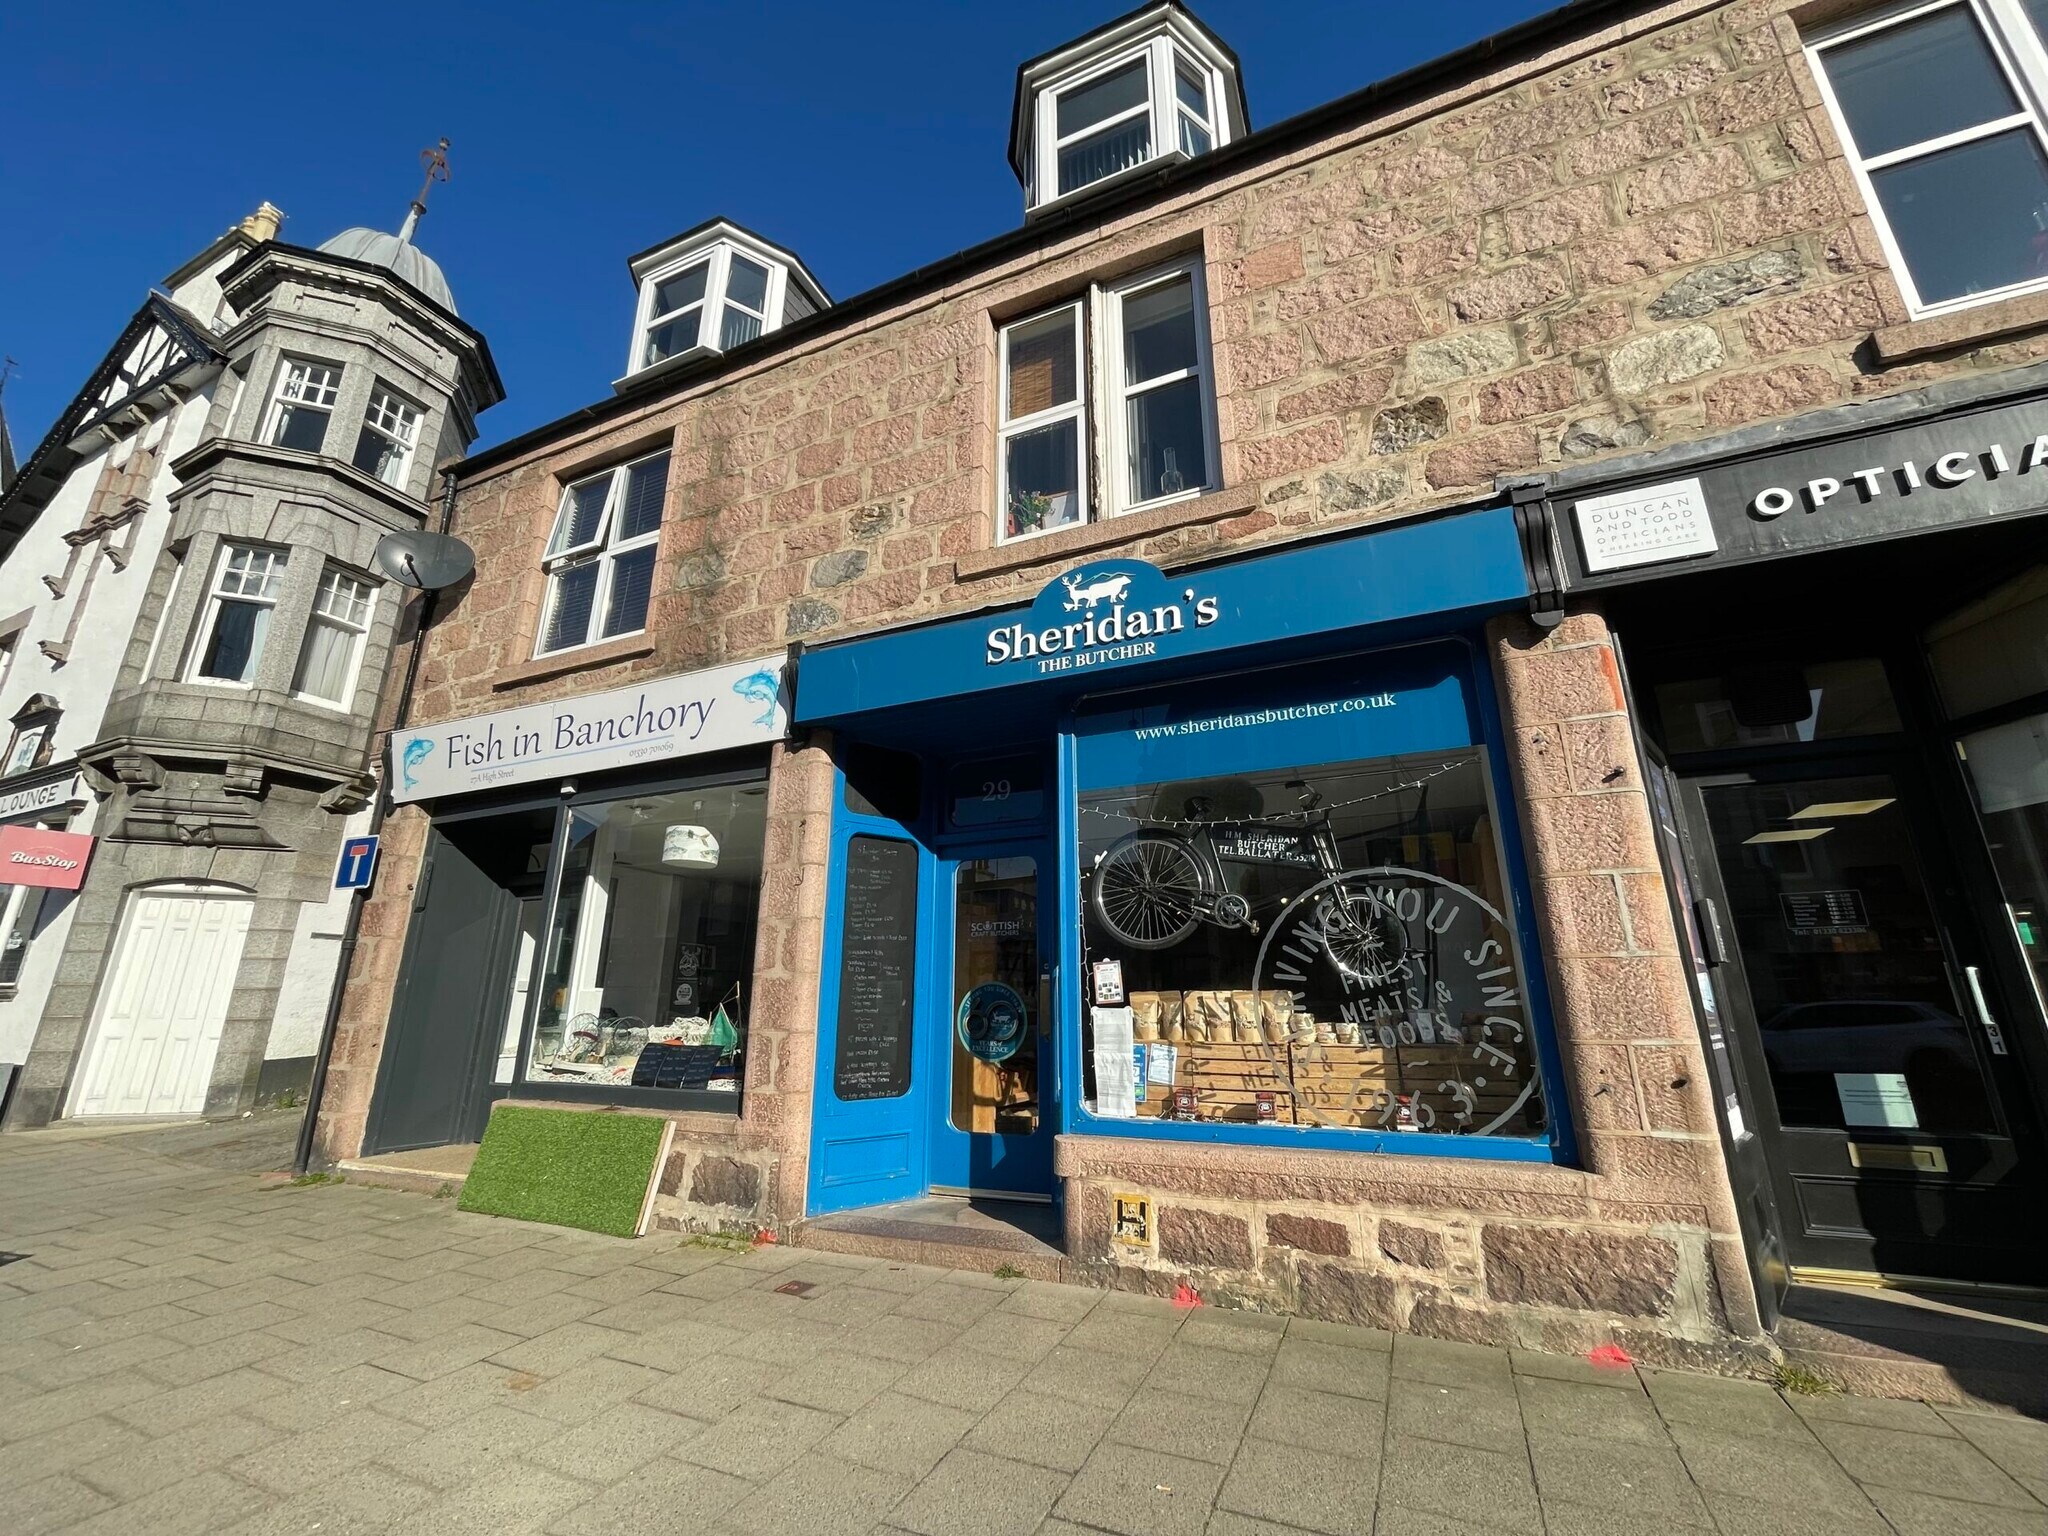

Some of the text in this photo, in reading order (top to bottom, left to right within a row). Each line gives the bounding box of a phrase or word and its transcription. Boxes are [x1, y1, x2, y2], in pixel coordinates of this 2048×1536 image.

[1754, 434, 2048, 516] OPTICIA
[1592, 497, 1690, 523] DUNCAN
[1595, 510, 1693, 534] AND TODD
[1597, 521, 1696, 545] OPTICIANS
[1610, 538, 1662, 552] HEARING
[1667, 532, 1698, 542] CARE
[987, 588, 1219, 664] Sheridan's
[1038, 641, 1156, 674] THE BUTCHER
[446, 694, 717, 770] Fish in Banchory
[1134, 693, 1397, 741] www.sheridansbutcher.co.uk
[482, 770, 497, 784] High
[497, 769, 515, 780] Street
[982, 780, 1011, 801] 29
[0, 784, 60, 814] LOUNGE
[1237, 839, 1285, 852] BUTCHER
[1247, 832, 1299, 845] SHERIDAN
[971, 920, 1020, 931] SCOTTISH
[1340, 952, 1427, 995] FINEST
[1366, 885, 1460, 934] YOU
[1464, 939, 1524, 1077] SINCE
[1340, 980, 1454, 1025] MEATS &
[1341, 1079, 1474, 1129] 1963
